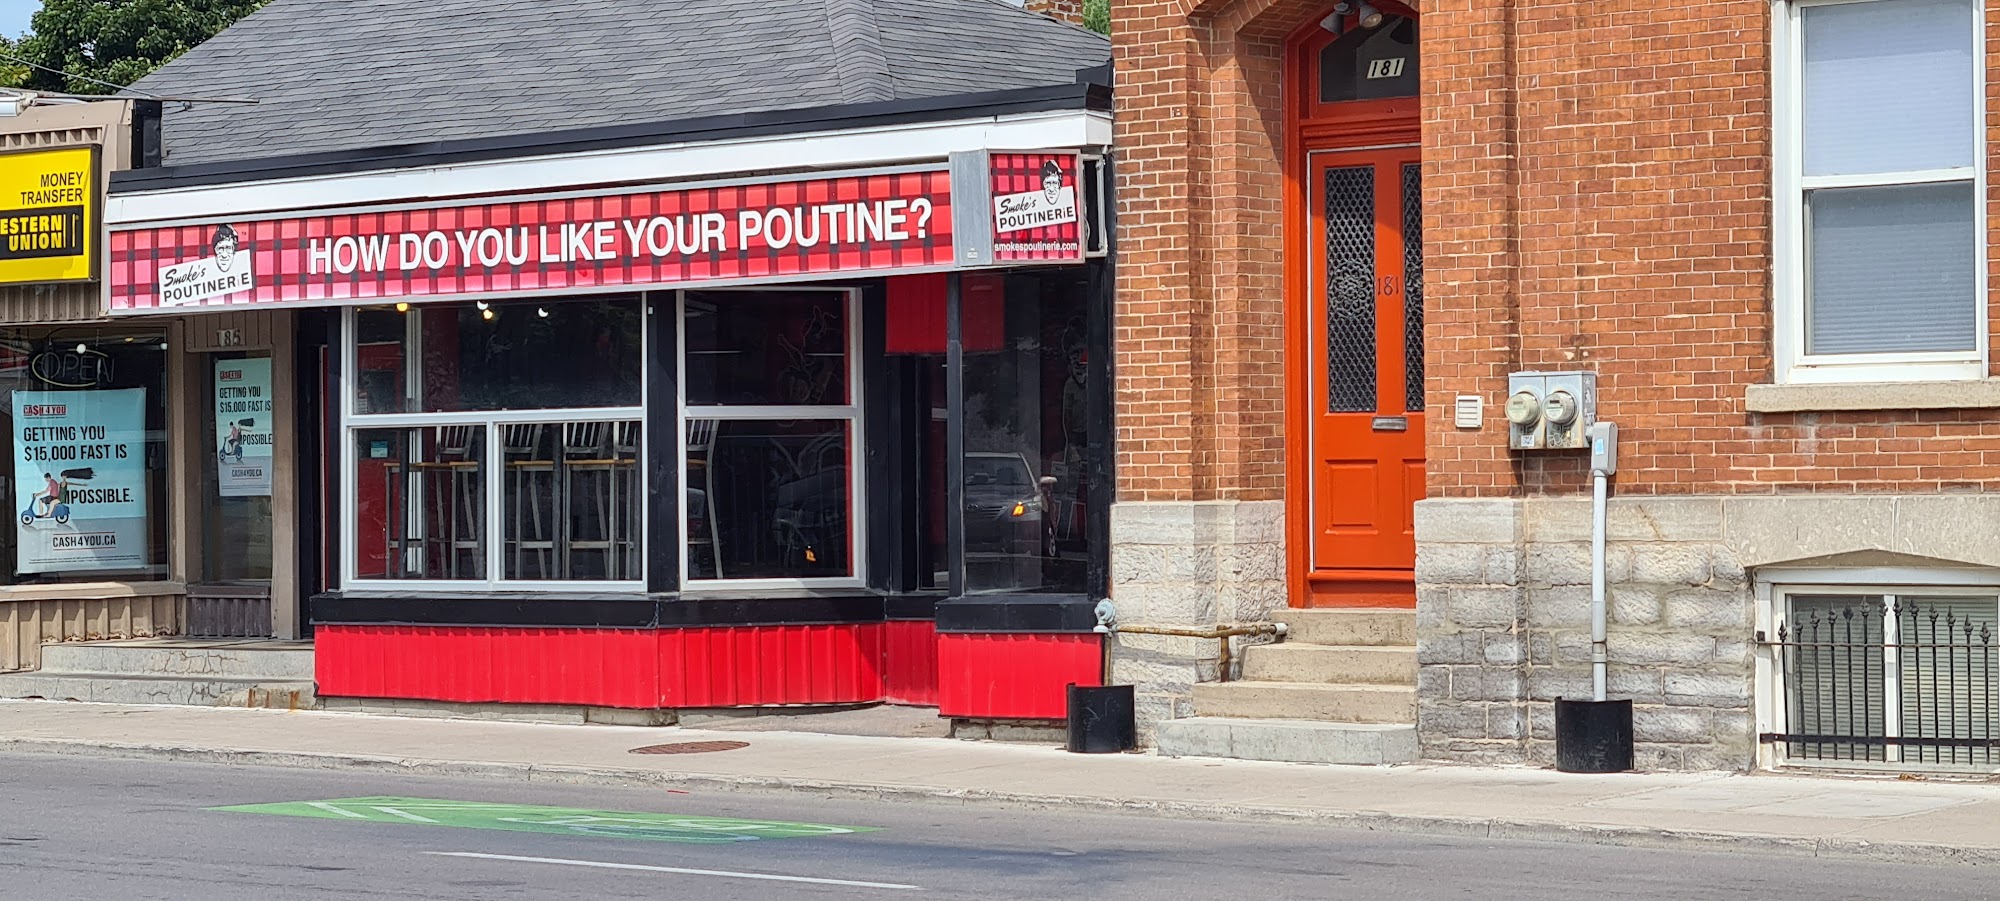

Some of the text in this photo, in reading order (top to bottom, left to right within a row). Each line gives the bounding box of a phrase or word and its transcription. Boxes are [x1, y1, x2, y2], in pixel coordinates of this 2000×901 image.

[1371, 59, 1400, 77] 181
[40, 171, 84, 188] MONEY
[20, 187, 83, 205] TRANSFER
[1000, 196, 1037, 215] Smoke's
[0, 214, 62, 235] ESTERN
[8, 231, 62, 252] UNION
[310, 197, 932, 275] HOW DO YOU LIKE YOUR POUTINE?
[994, 241, 1078, 253] smokespoutinerie.com
[163, 265, 207, 288] Smoke's
[1377, 275, 1399, 296] 181
[41, 352, 114, 383] OPEN
[219, 386, 261, 399] GETTING YOU
[52, 405, 67, 415] YOU
[247, 400, 264, 412] FAST
[265, 400, 272, 411] IS
[23, 425, 105, 442] GETTING YOU
[24, 443, 128, 462] $15,000 FAST IS
